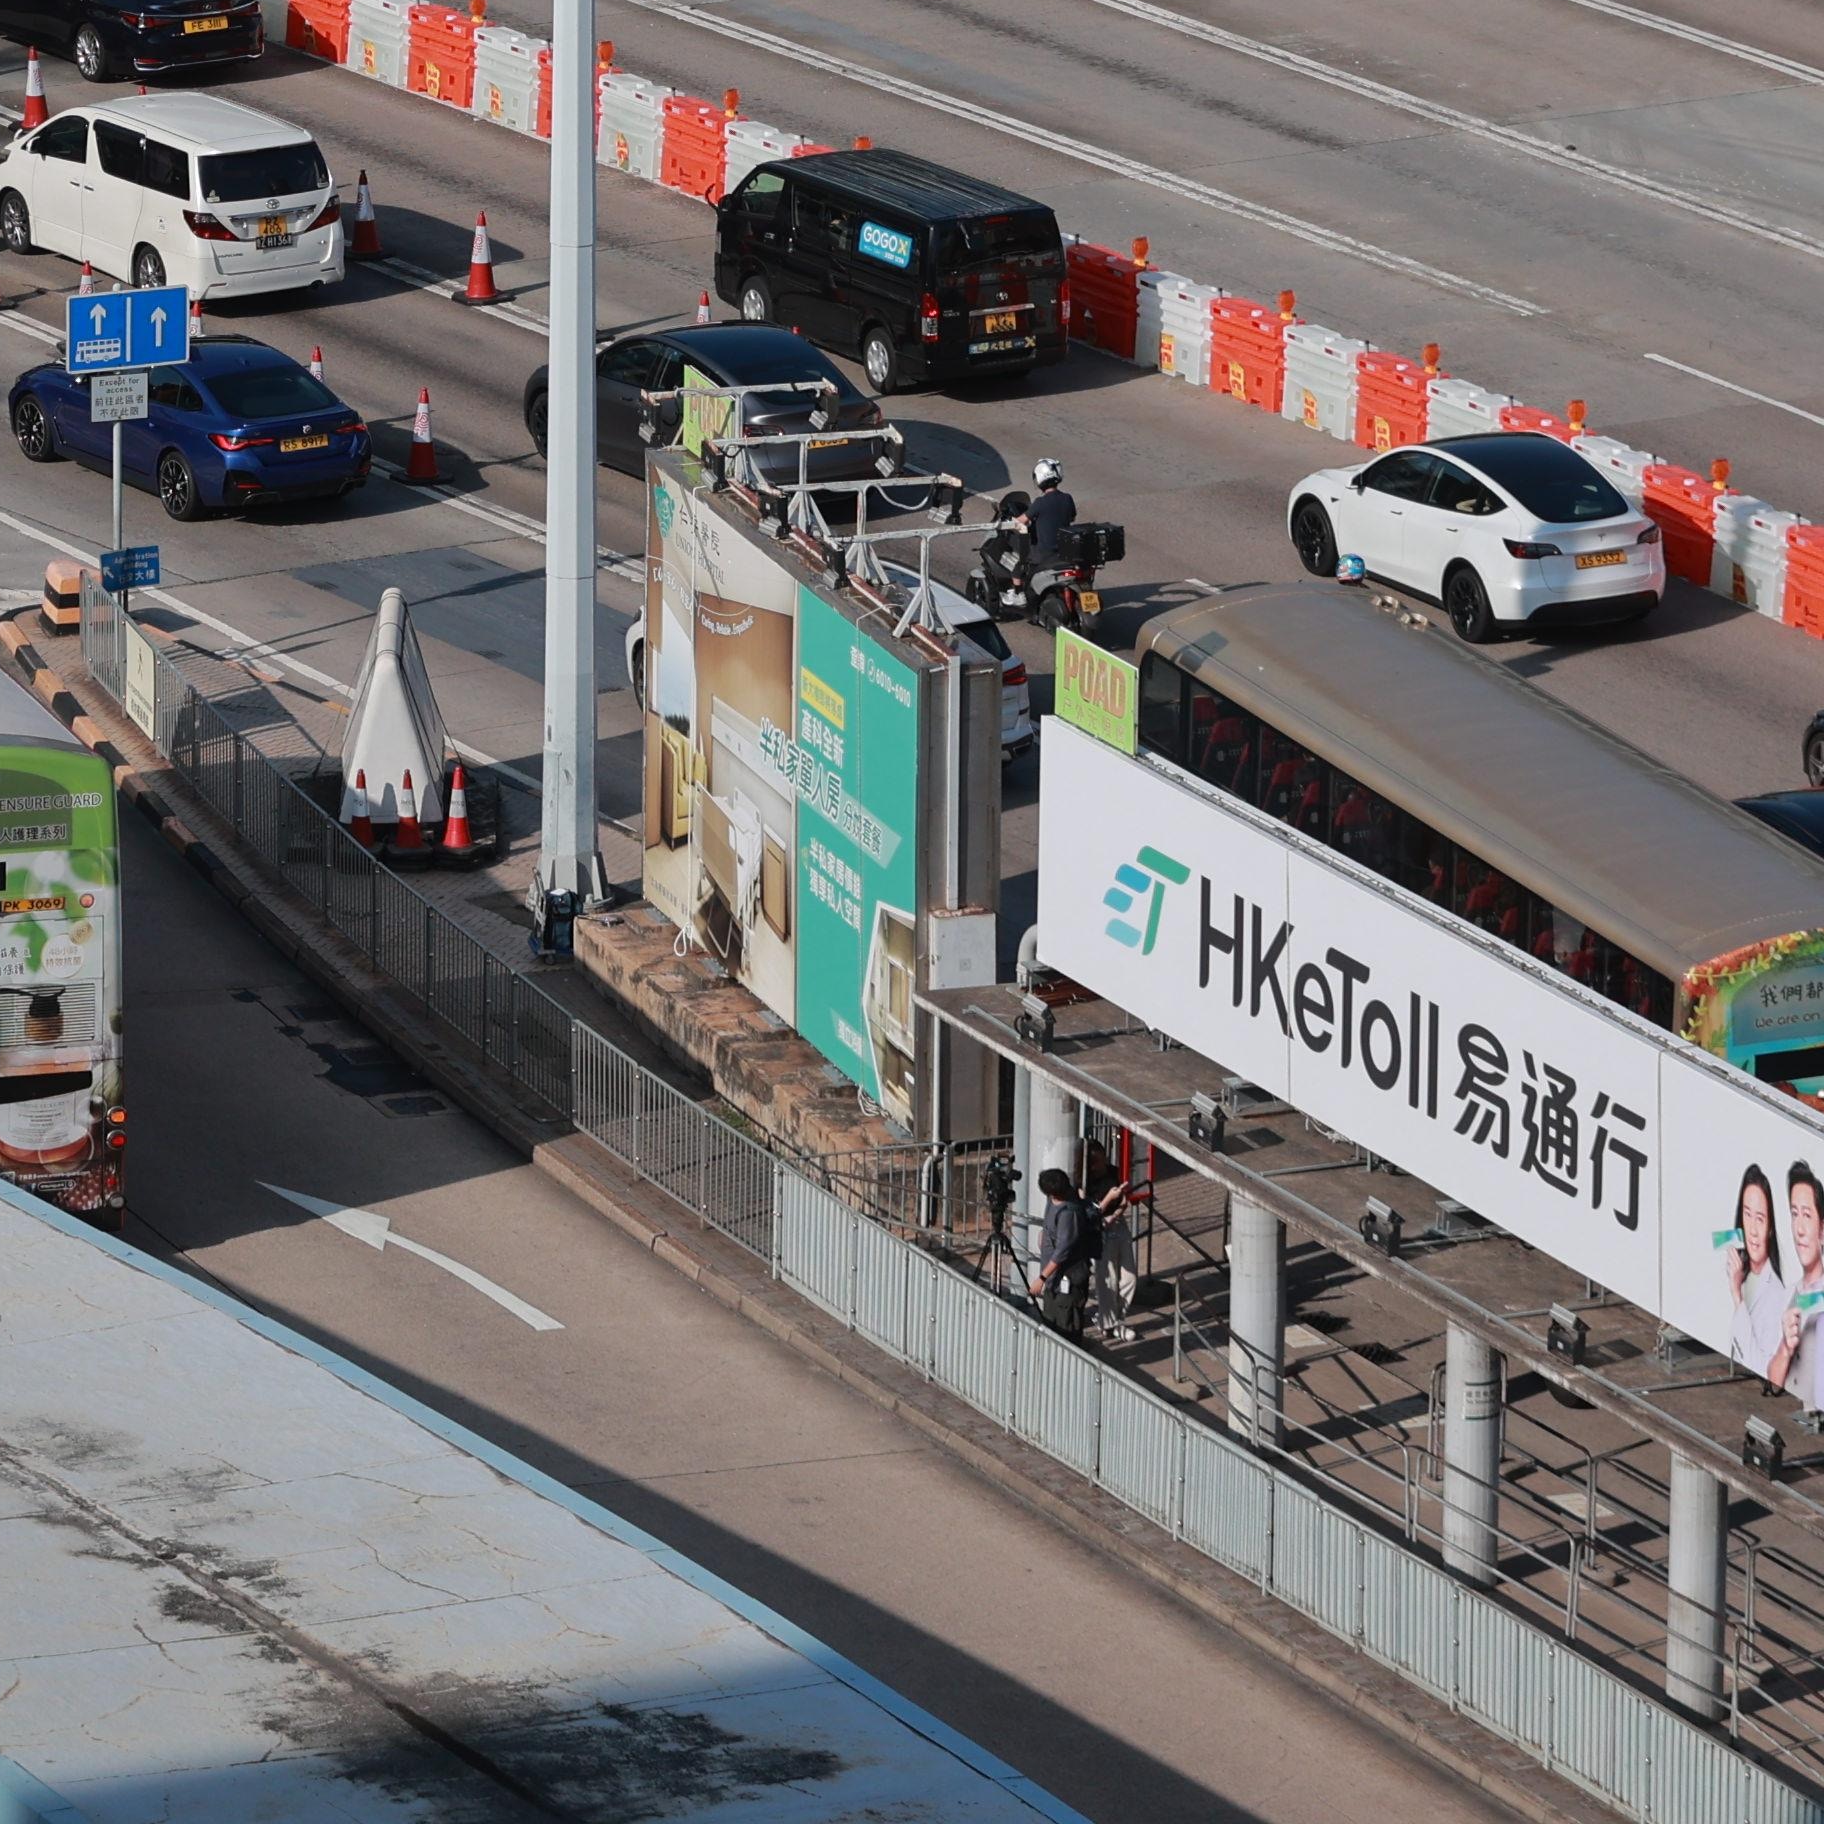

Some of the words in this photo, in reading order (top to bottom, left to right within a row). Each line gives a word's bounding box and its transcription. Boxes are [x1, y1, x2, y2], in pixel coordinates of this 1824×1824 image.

[863, 224, 908, 257] GOGOX
[99, 378, 126, 388] Except
[99, 406, 139, 417] 不在此限
[875, 668, 911, 708] 6010-6010
[1064, 640, 1126, 719] POAD
[53, 792, 103, 808] GUARD
[3, 901, 21, 912] PK
[27, 898, 62, 910] 3069
[1198, 874, 1440, 1120] HKeToll
[1455, 1021, 1650, 1234] 易通行
